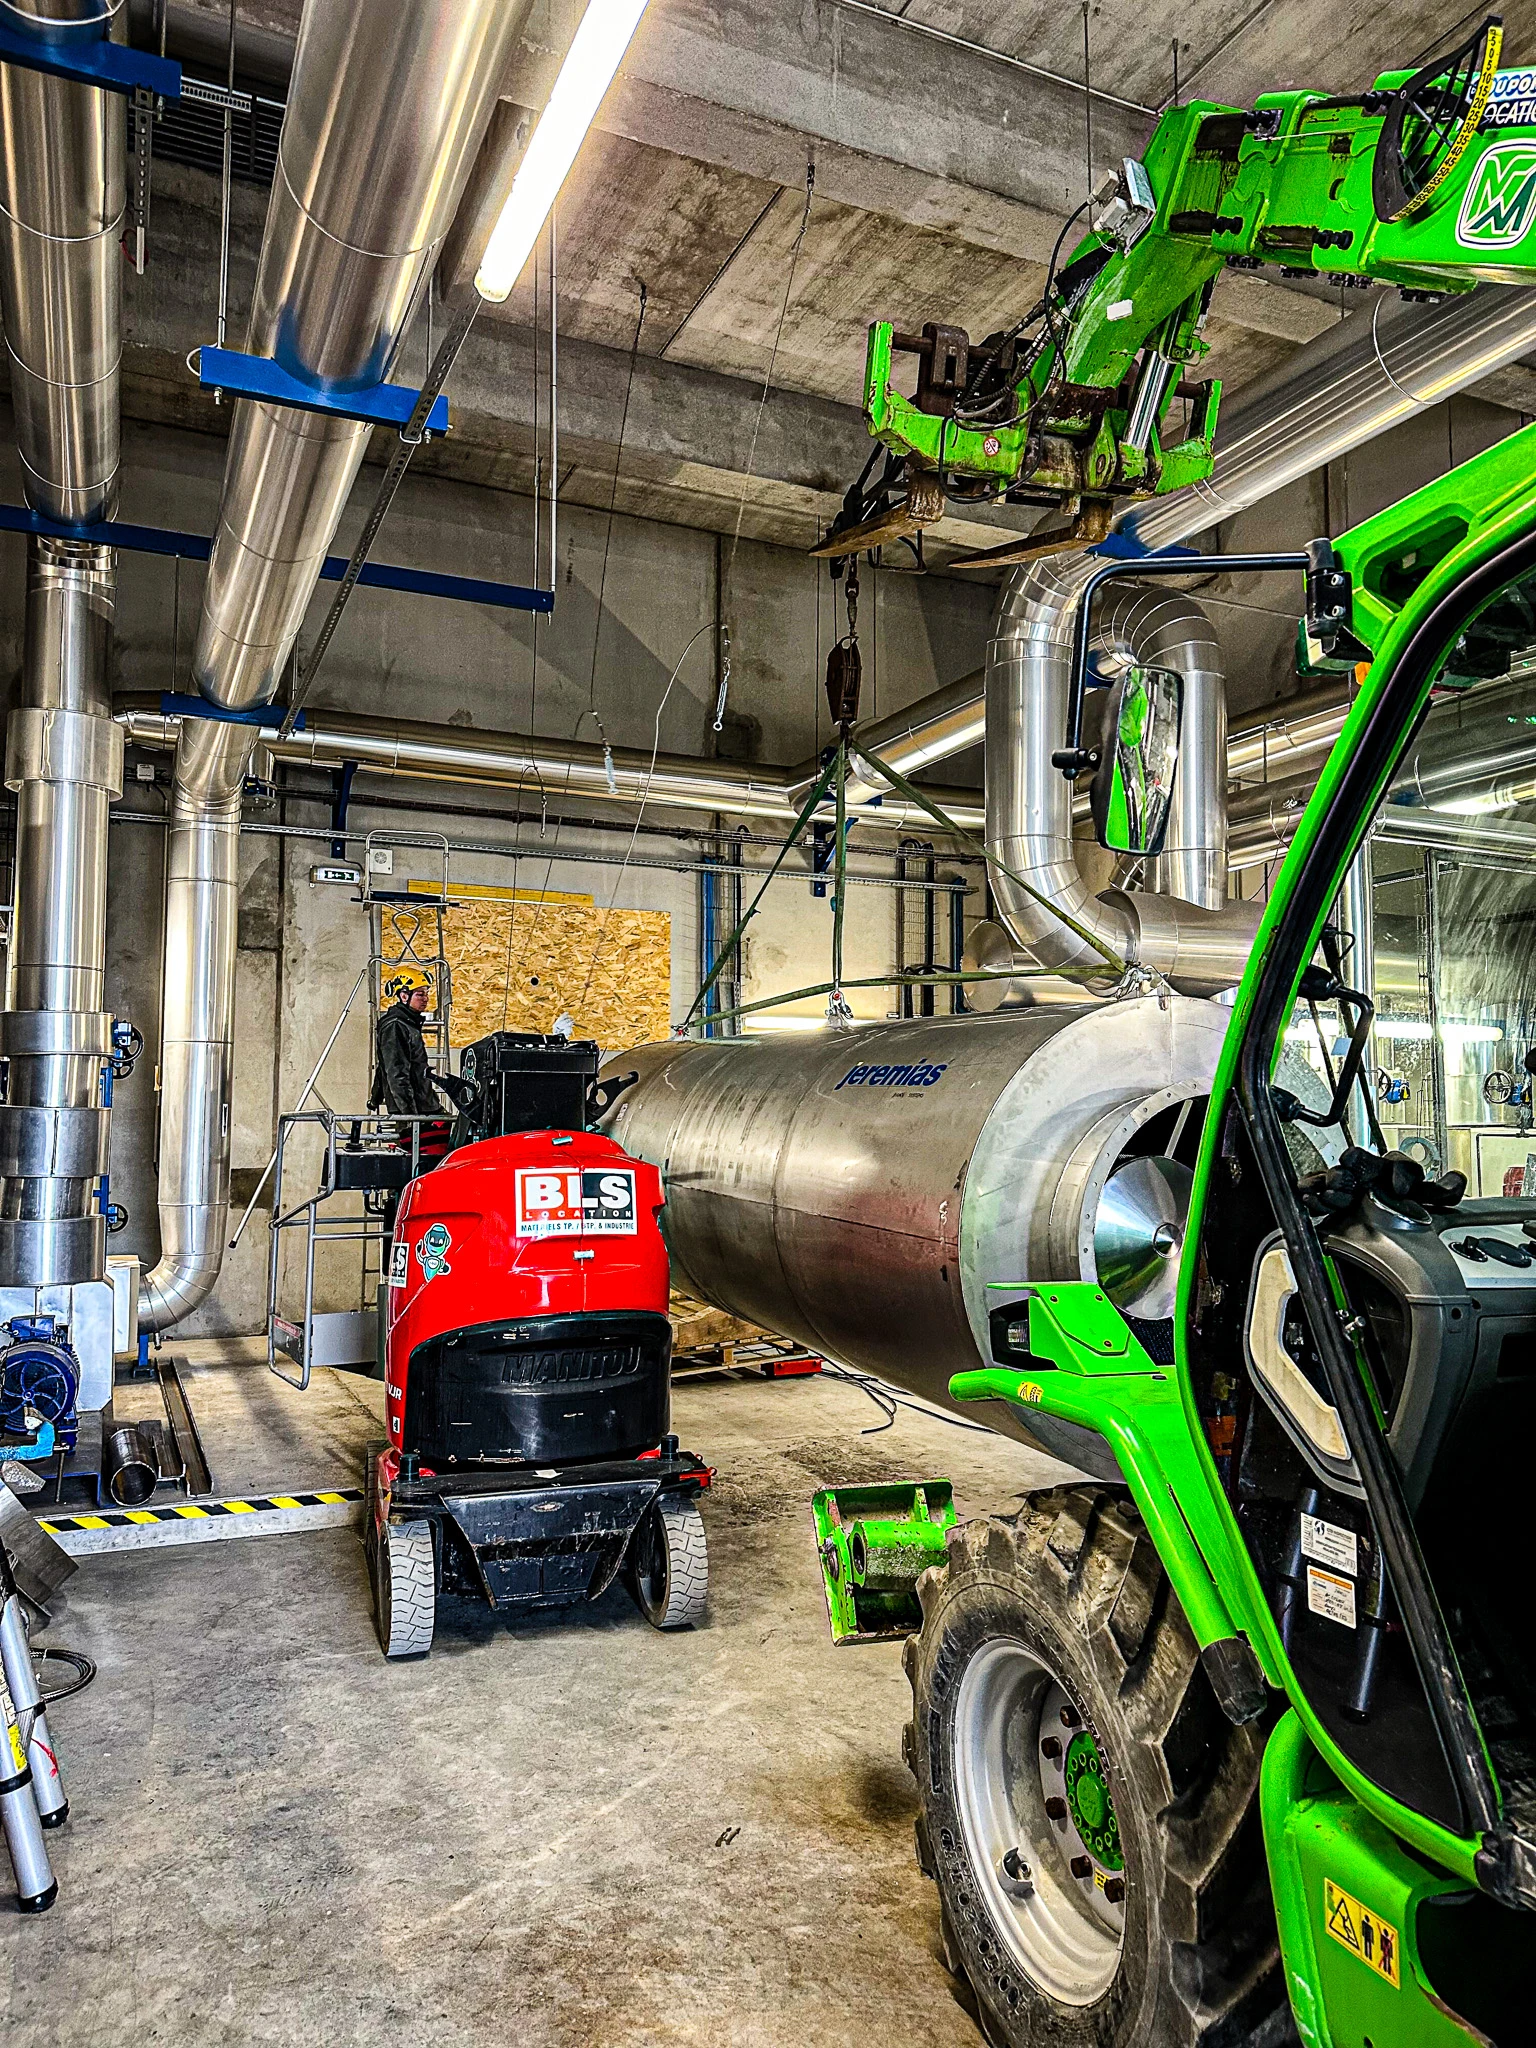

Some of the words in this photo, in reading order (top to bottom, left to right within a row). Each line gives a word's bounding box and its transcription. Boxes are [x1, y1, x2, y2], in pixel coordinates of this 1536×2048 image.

[1482, 72, 1491, 84] 10
[1479, 85, 1489, 97] 15
[1473, 98, 1484, 109] 20
[1468, 110, 1480, 121] 25
[1463, 122, 1474, 133] 30
[1457, 134, 1469, 145] 35
[1451, 146, 1462, 156] 40
[1444, 157, 1457, 167] 45
[525, 1175, 631, 1210] BLS
[525, 1210, 632, 1219] LOCATION
[501, 1346, 640, 1383] MANITOU
